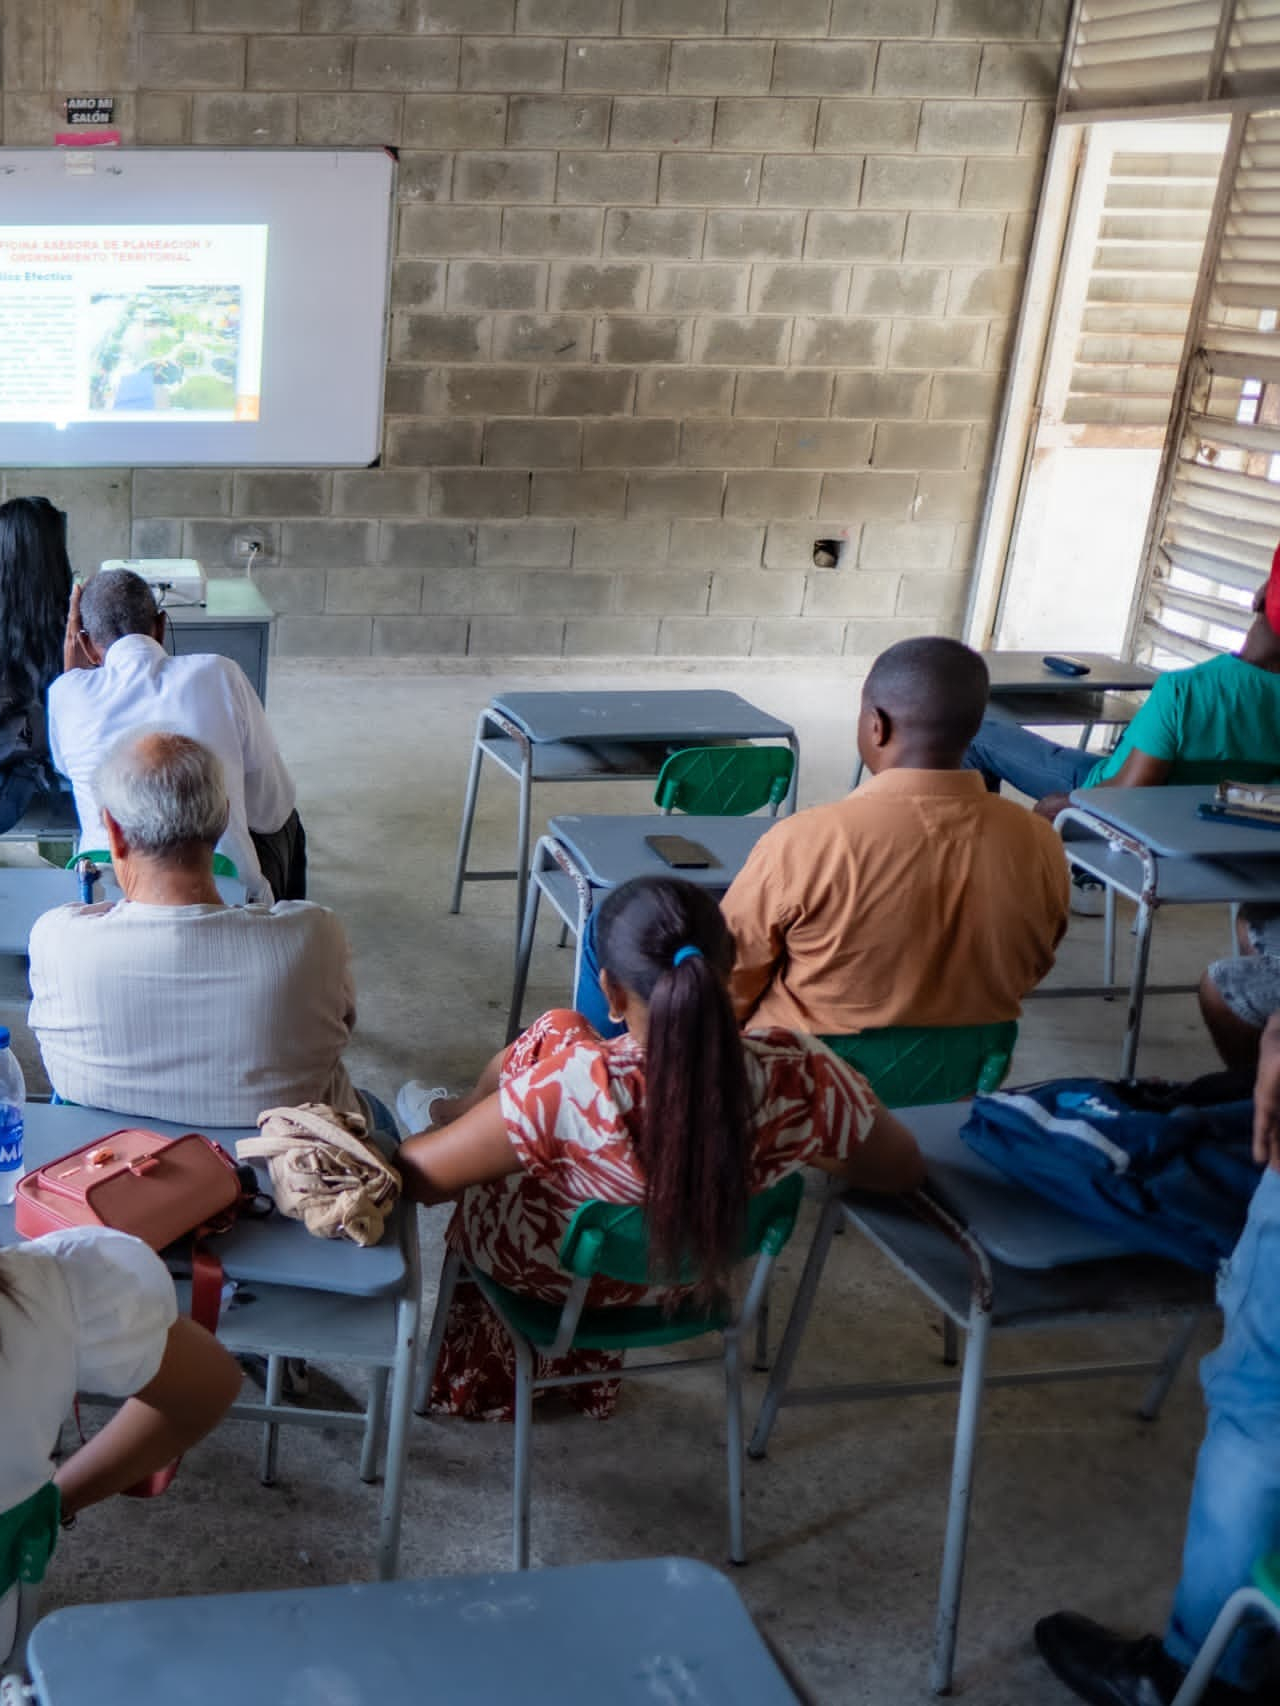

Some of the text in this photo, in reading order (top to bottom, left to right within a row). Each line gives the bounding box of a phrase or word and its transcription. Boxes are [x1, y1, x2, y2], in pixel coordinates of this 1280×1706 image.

[68, 98, 113, 109] AMO MI
[71, 110, 110, 123] SALÓN
